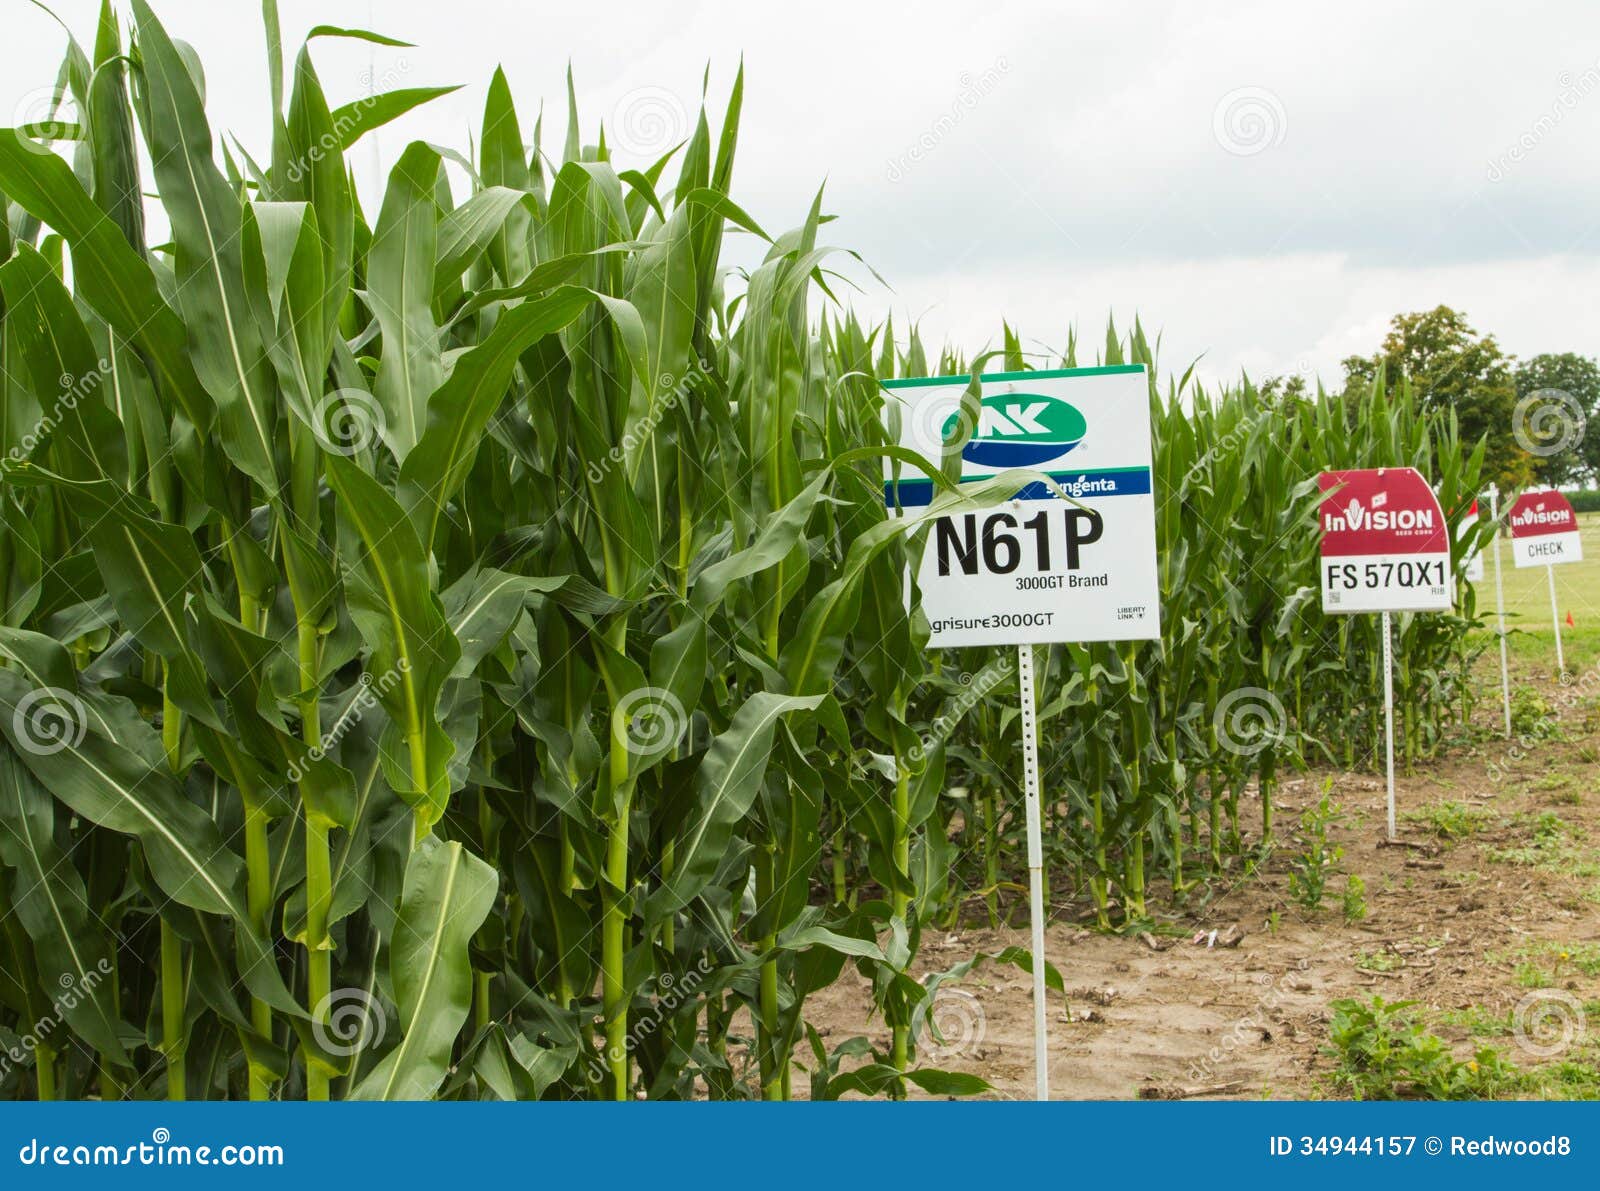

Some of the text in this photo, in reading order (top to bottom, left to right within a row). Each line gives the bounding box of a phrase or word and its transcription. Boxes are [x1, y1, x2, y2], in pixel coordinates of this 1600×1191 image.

[977, 402, 1053, 437] NK
[936, 507, 1104, 577] N61P
[1528, 541, 1563, 557] CHECK
[1016, 573, 1108, 590] 3000GT Brand
[1328, 561, 1444, 590] FS 57QX1
